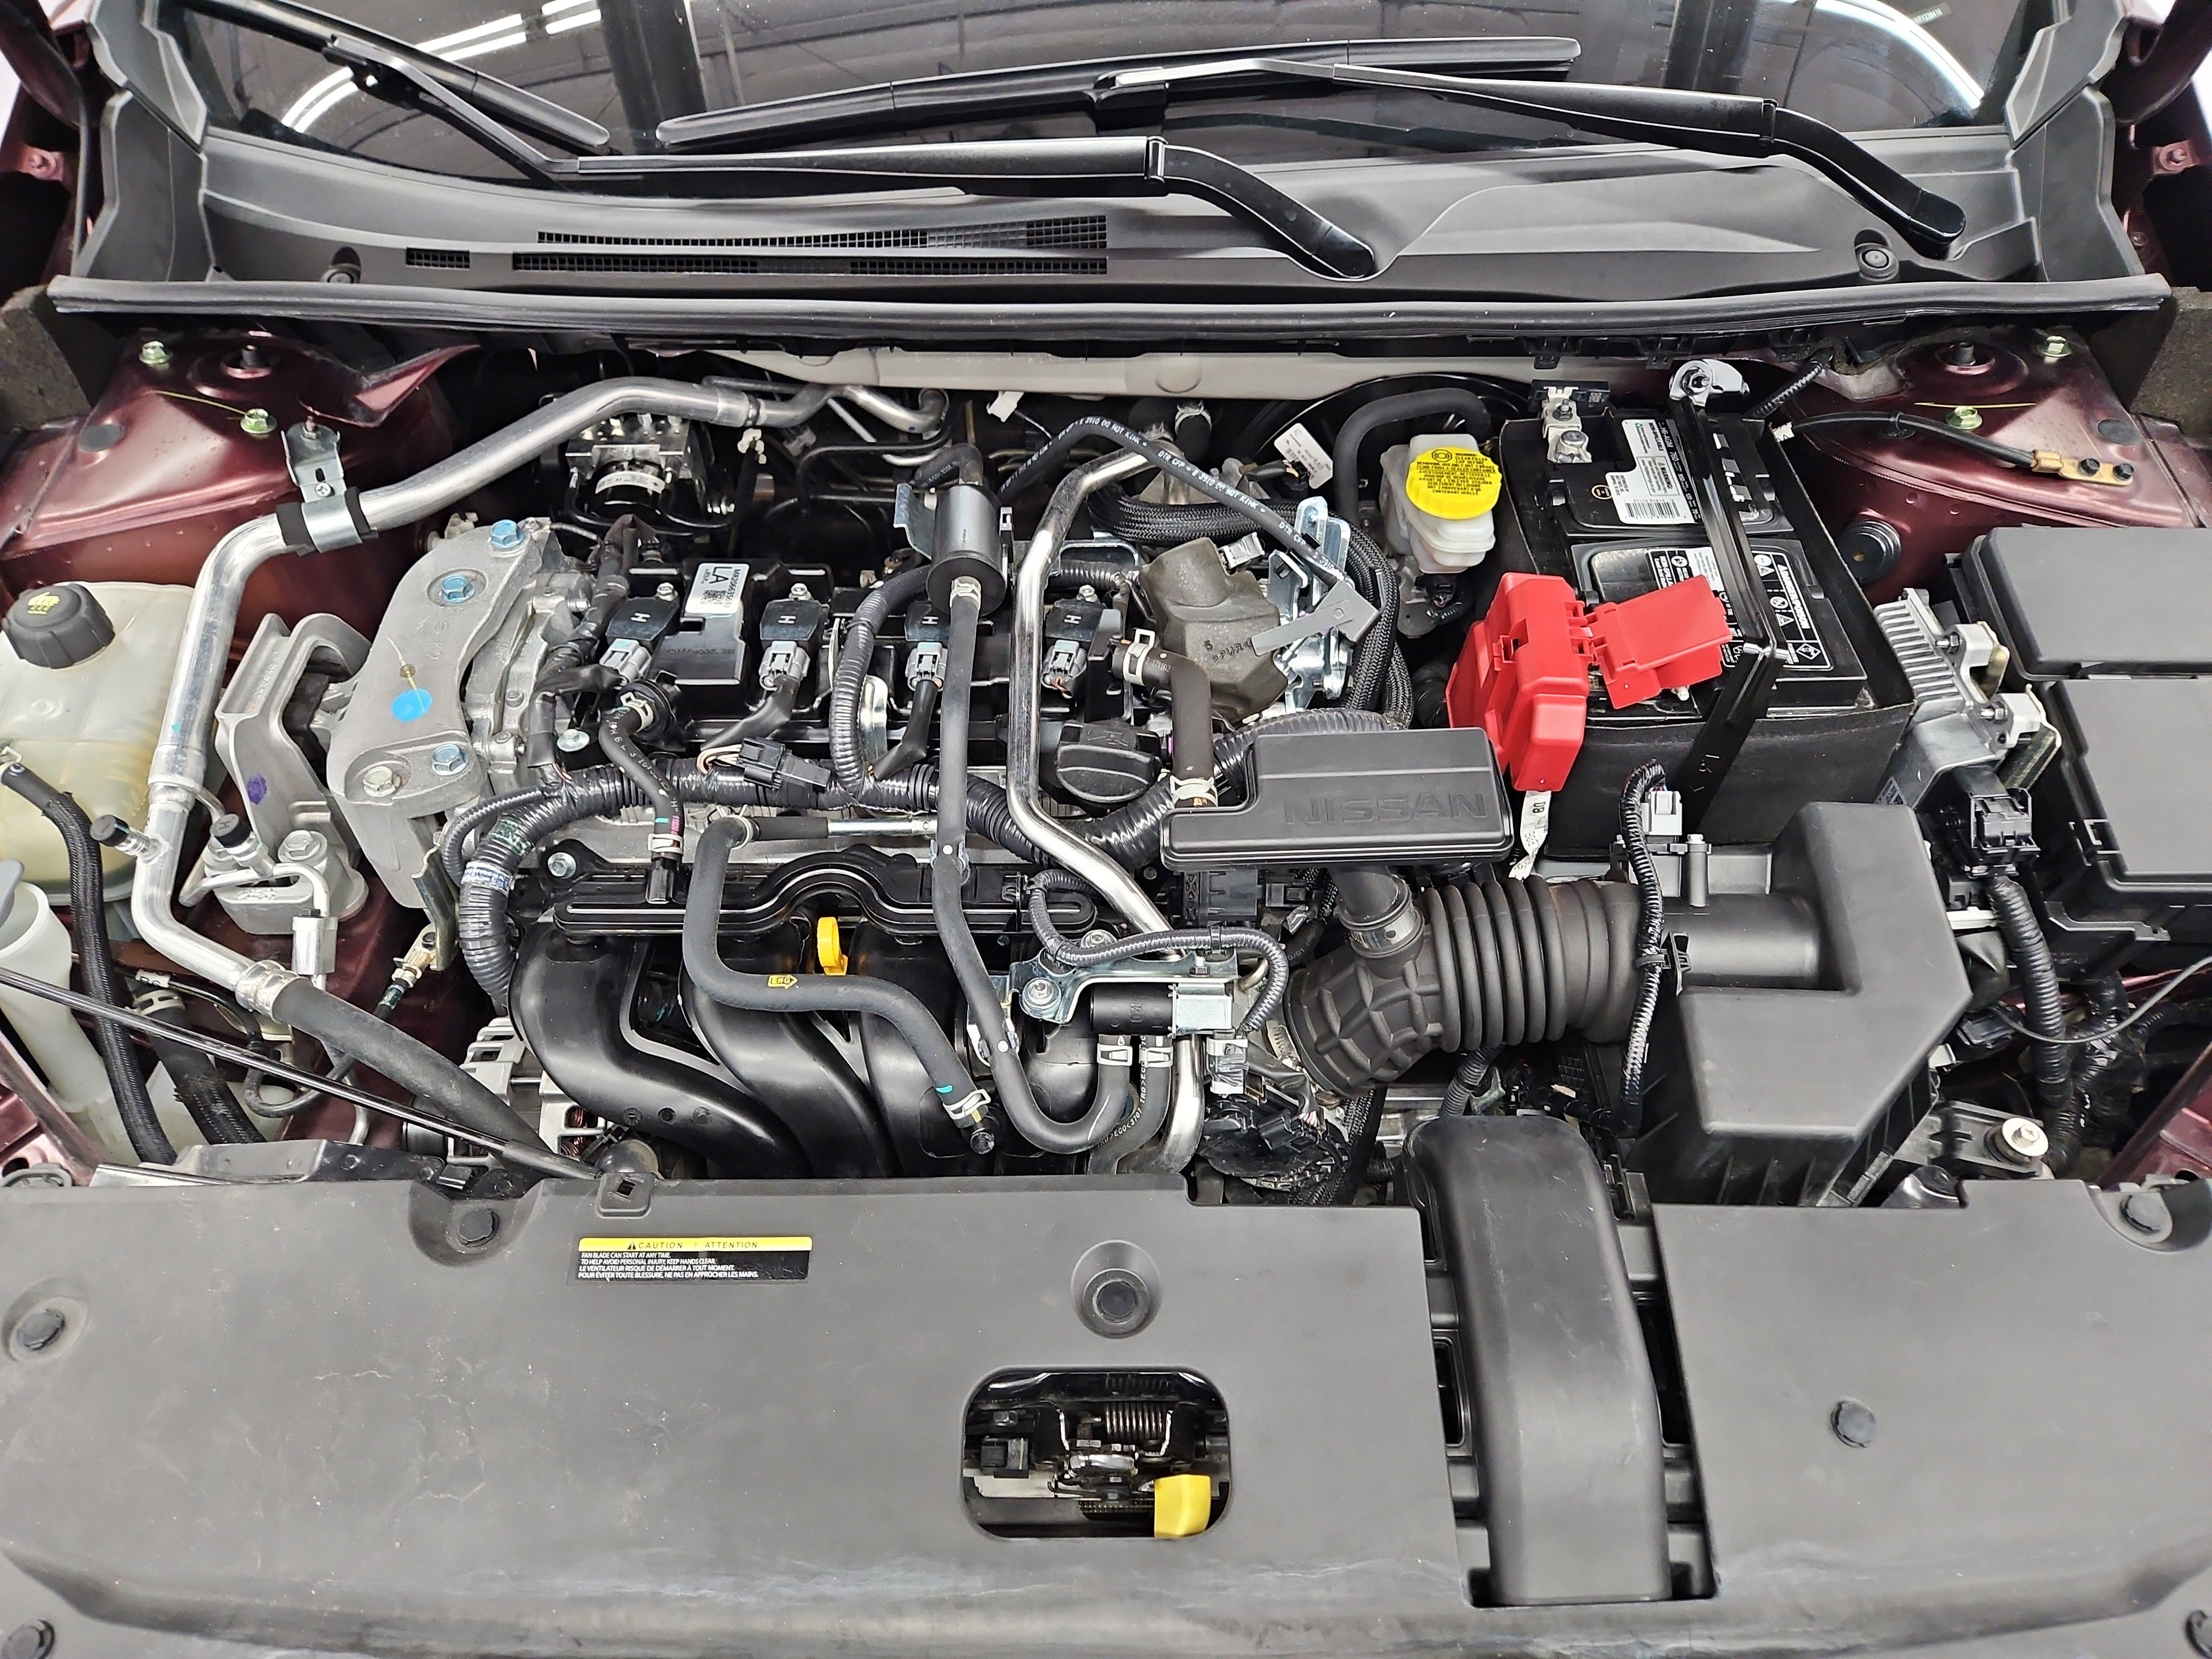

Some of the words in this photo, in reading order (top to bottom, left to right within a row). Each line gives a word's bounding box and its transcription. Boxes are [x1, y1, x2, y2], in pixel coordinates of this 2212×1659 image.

[1111, 422, 1124, 434] NOT
[1126, 431, 1142, 445] KINK
[1669, 452, 1679, 461] 760
[1225, 487, 1239, 499] NOT
[1239, 494, 1258, 510] KINK
[1279, 522, 1293, 536] DTR
[709, 567, 732, 584] LA
[1284, 792, 1488, 825] NISSAN
